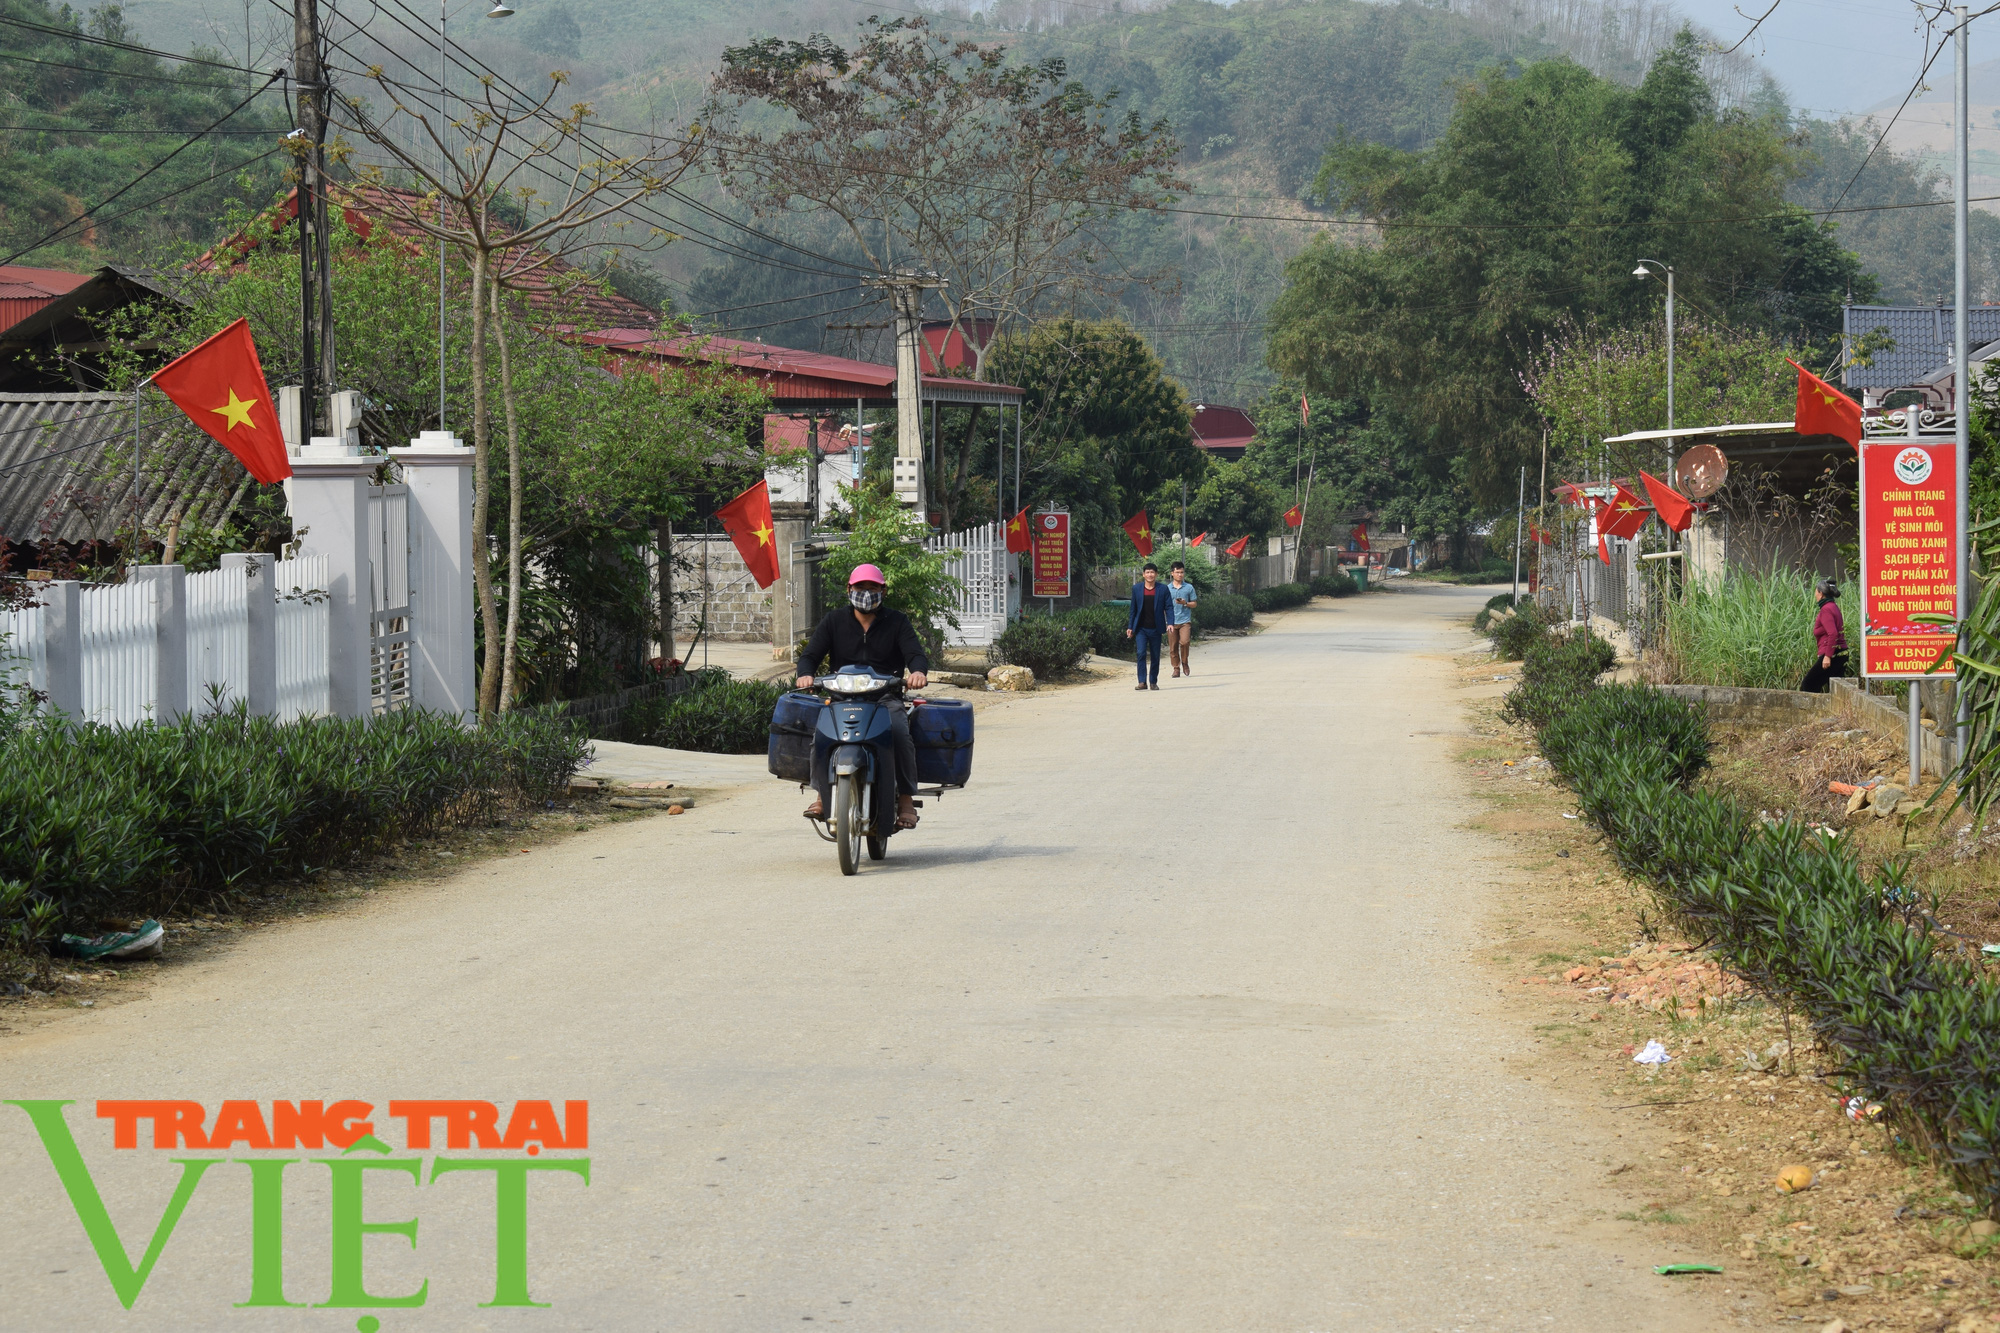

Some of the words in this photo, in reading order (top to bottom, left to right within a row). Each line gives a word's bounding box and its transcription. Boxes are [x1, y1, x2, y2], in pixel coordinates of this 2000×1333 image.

[1882, 488, 1911, 501] CHỈNH
[1914, 490, 1945, 500] TRANG
[1894, 505, 1912, 516] NHÀ
[1916, 502, 1934, 516] CỬA
[1885, 520, 1896, 534] VỆ
[1900, 522, 1922, 532] SINH
[1924, 520, 1943, 532] MÔI
[1881, 536, 1918, 548] TRƯỜNG
[1922, 538, 1947, 548] XANH
[1884, 554, 1909, 566] SẠCH
[1912, 554, 1930, 566] ĐẸP
[1933, 552, 1944, 563] LÀ
[1881, 568, 1899, 580] GÓP
[1931, 567, 1949, 579] XÂY
[1871, 585, 1897, 598] DỰNG
[1900, 583, 1930, 595] THÀNH
[1933, 583, 1957, 595] CÔNG
[1878, 600, 1904, 611] NÔNG
[1907, 599, 1931, 611] THÔN
[1934, 598, 1953, 611] MỚI
[1894, 648, 1937, 657] UBND
[1875, 660, 1890, 670] XÃ
[1894, 659, 1933, 670] MƯỜNG
